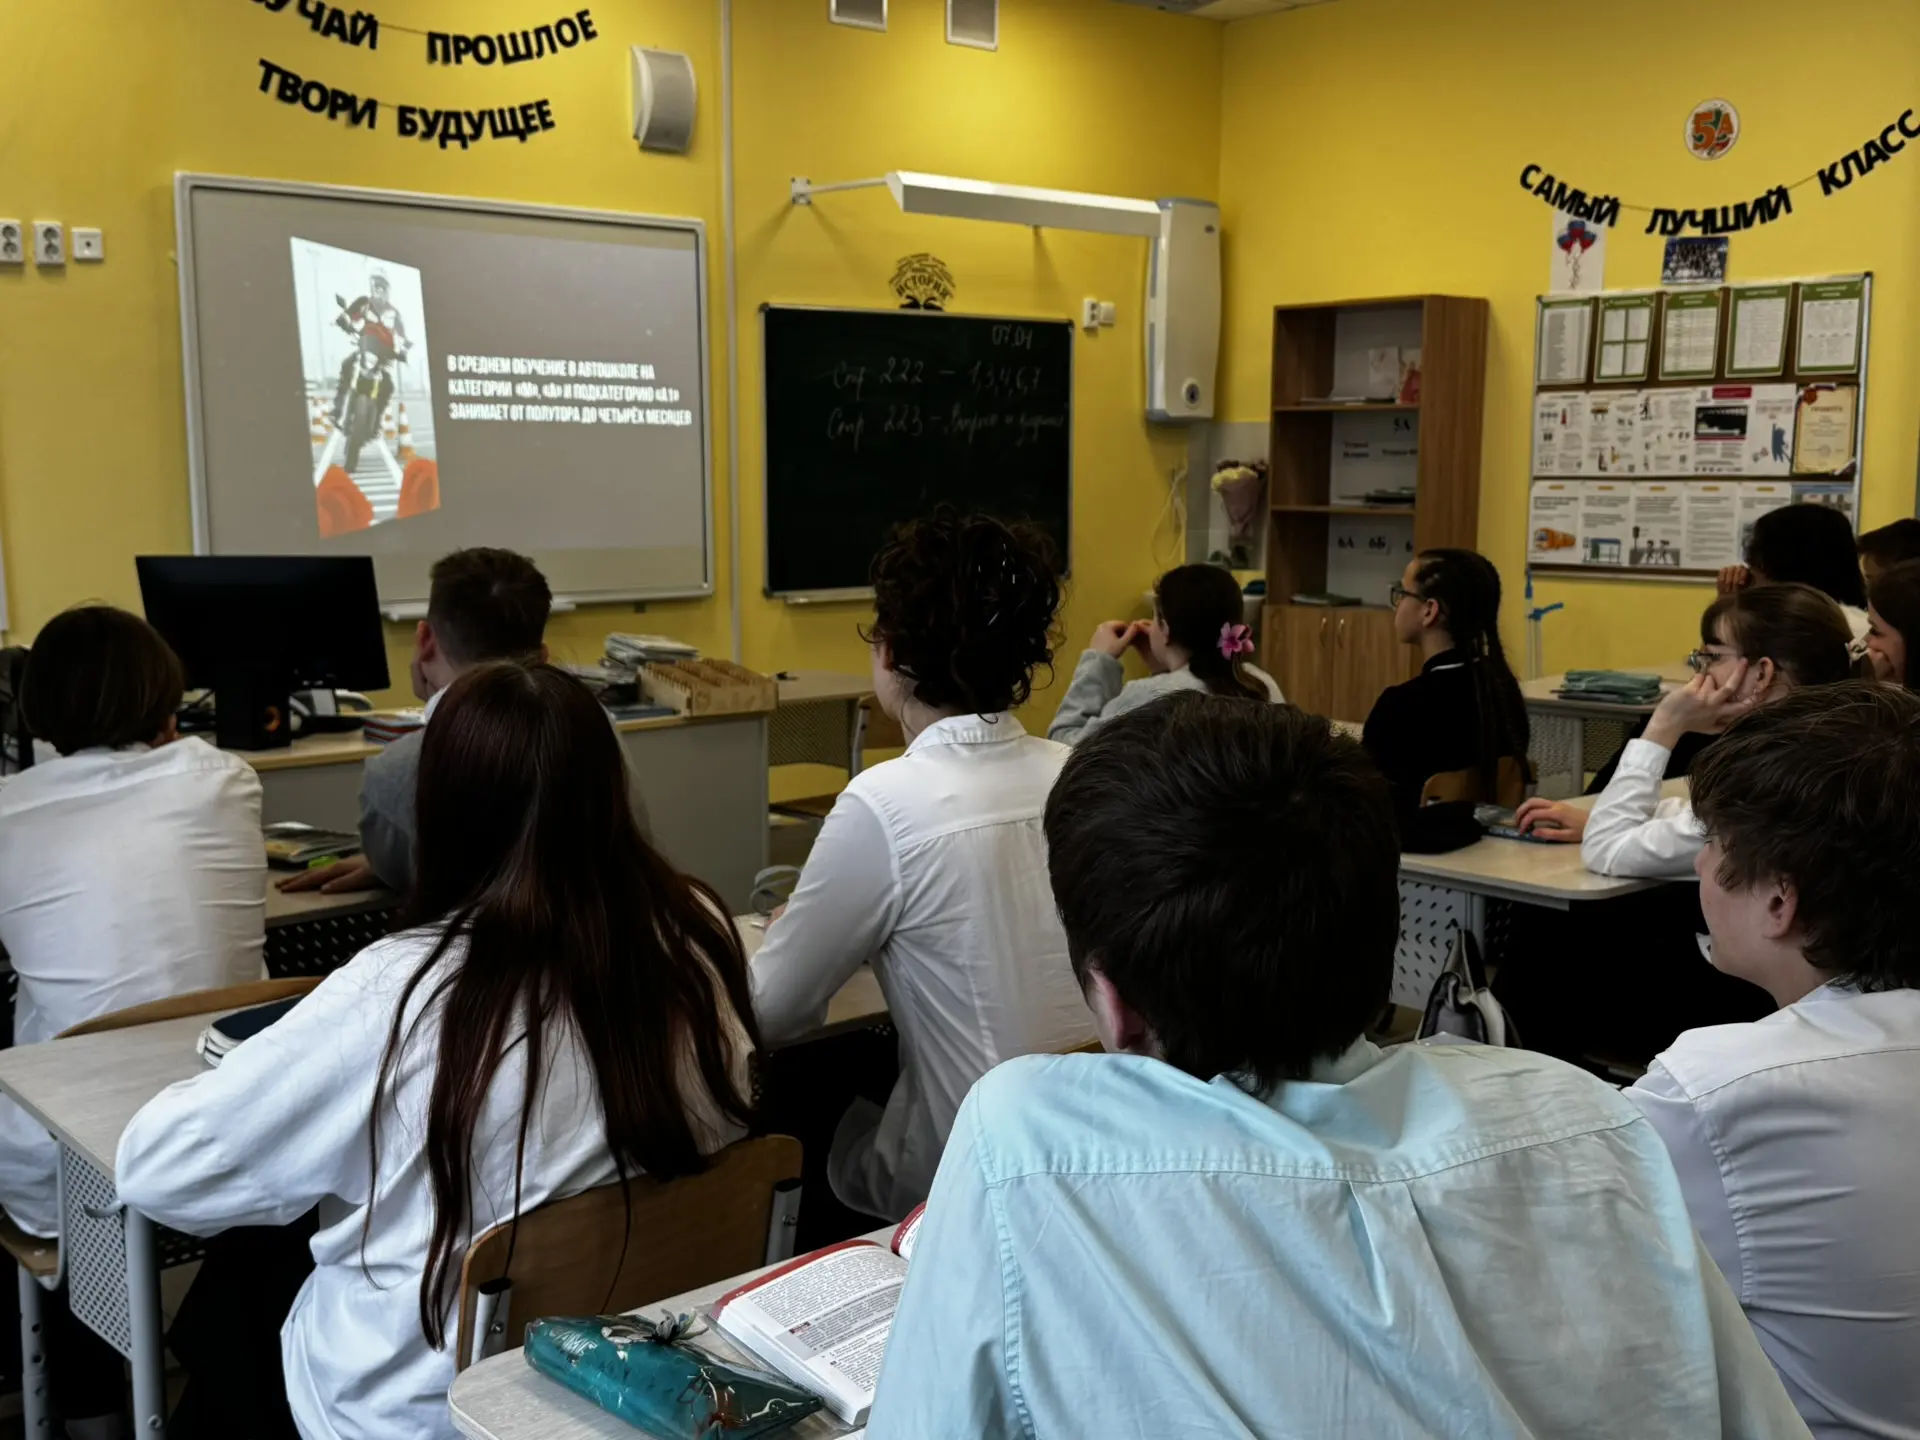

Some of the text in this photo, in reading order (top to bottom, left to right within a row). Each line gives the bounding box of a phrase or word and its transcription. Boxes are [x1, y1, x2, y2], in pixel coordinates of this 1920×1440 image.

[427, 9, 598, 65] ПРОШЛОЕ
[258, 58, 555, 150] ТВОРИ БУДУЩЕЕ
[1692, 111, 1734, 151] 5А
[1519, 108, 1920, 236] САМЫЙ ЛУЧШИЙ КЛАСС
[447, 354, 656, 380] В СРЕДНЕМ ОБУЧЕНИЕ В АВТОШКОЛЕ НА
[880, 356, 925, 385] 222
[448, 379, 513, 397] КАТЕГОРИИ
[562, 383, 573, 399] И
[572, 384, 655, 403] ПОДКАТЕГОРИЮ
[449, 403, 510, 421] ЗАНИМАЕТ
[509, 404, 525, 421] ОТ
[525, 405, 582, 423] ПОЛУТОРА
[581, 407, 598, 424] ДО
[645, 409, 693, 427] МЕСЯЦЕВ
[883, 403, 924, 438] 223
